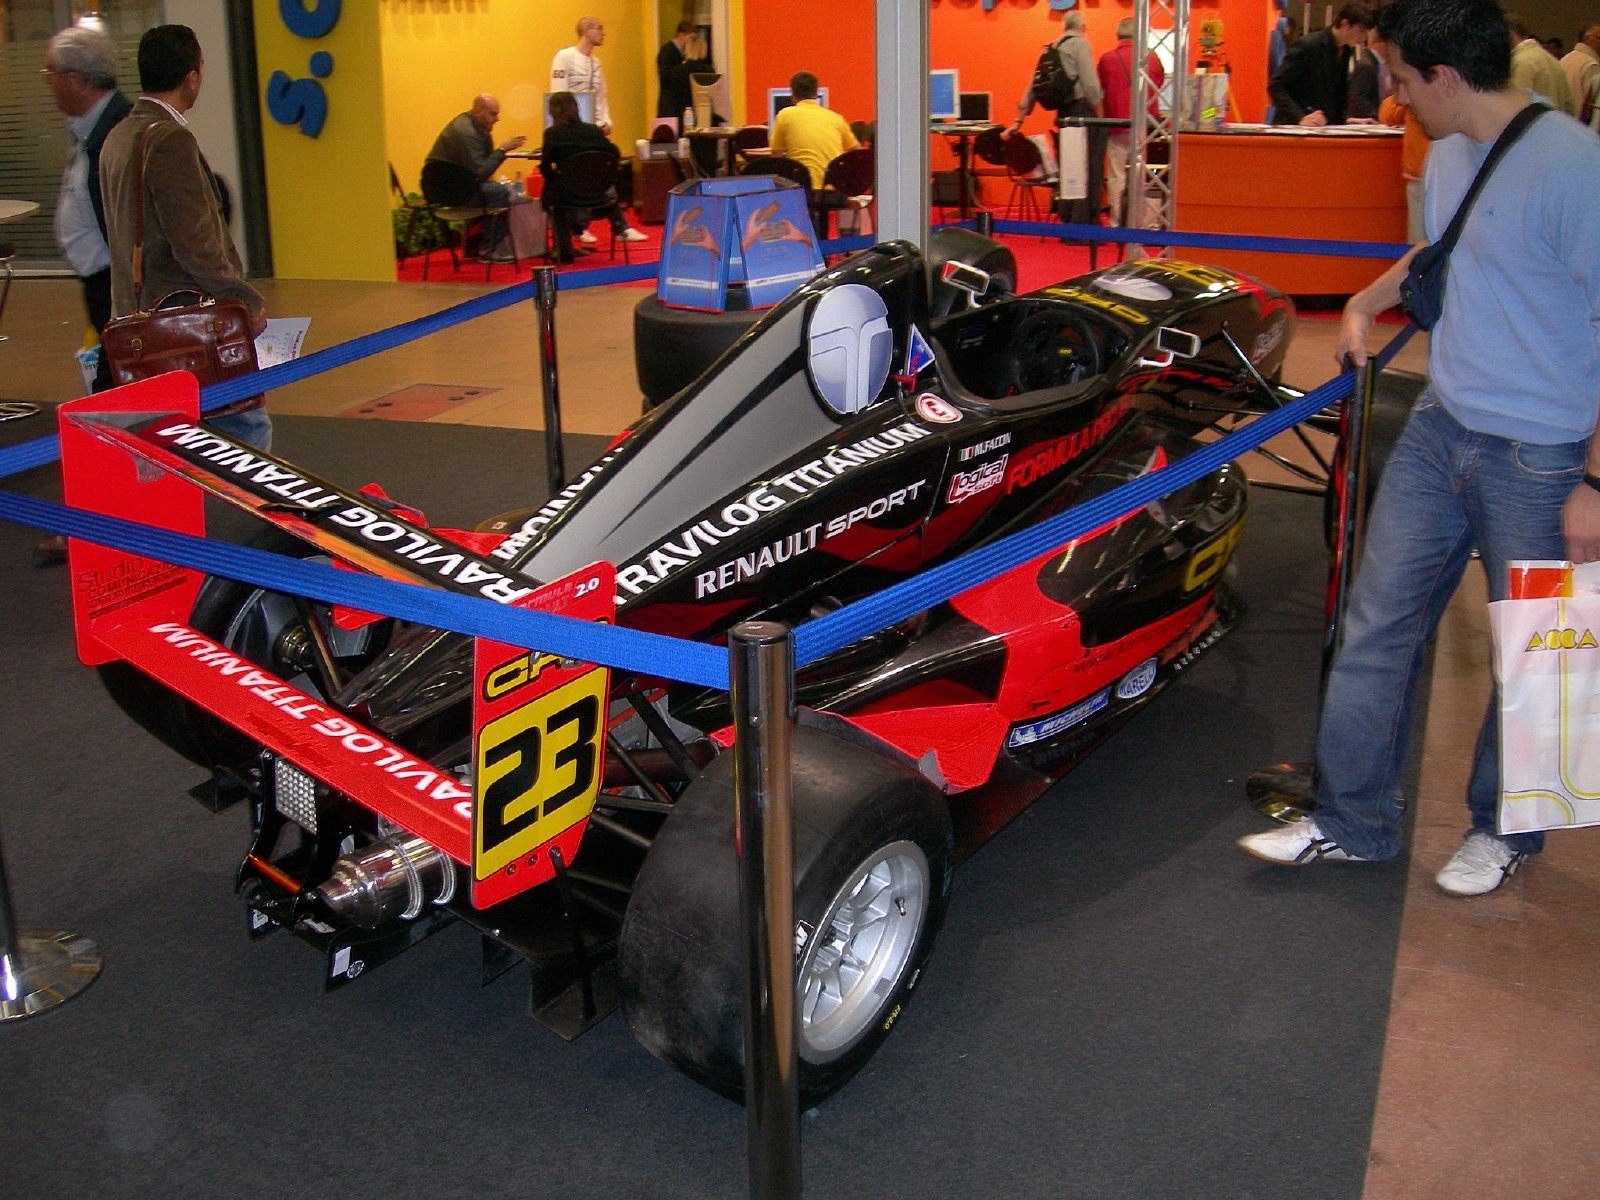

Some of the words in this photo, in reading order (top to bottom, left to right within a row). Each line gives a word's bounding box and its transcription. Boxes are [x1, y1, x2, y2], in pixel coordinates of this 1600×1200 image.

[157, 422, 341, 518] TITANIUM
[779, 421, 933, 498] TITANIUM
[694, 521, 824, 600] RENAULT
[825, 478, 927, 539] SPORT
[573, 577, 600, 598] 2.0
[147, 620, 336, 720] TITANIUM
[1525, 628, 1600, 652] ACCA
[484, 694, 602, 852] 23
